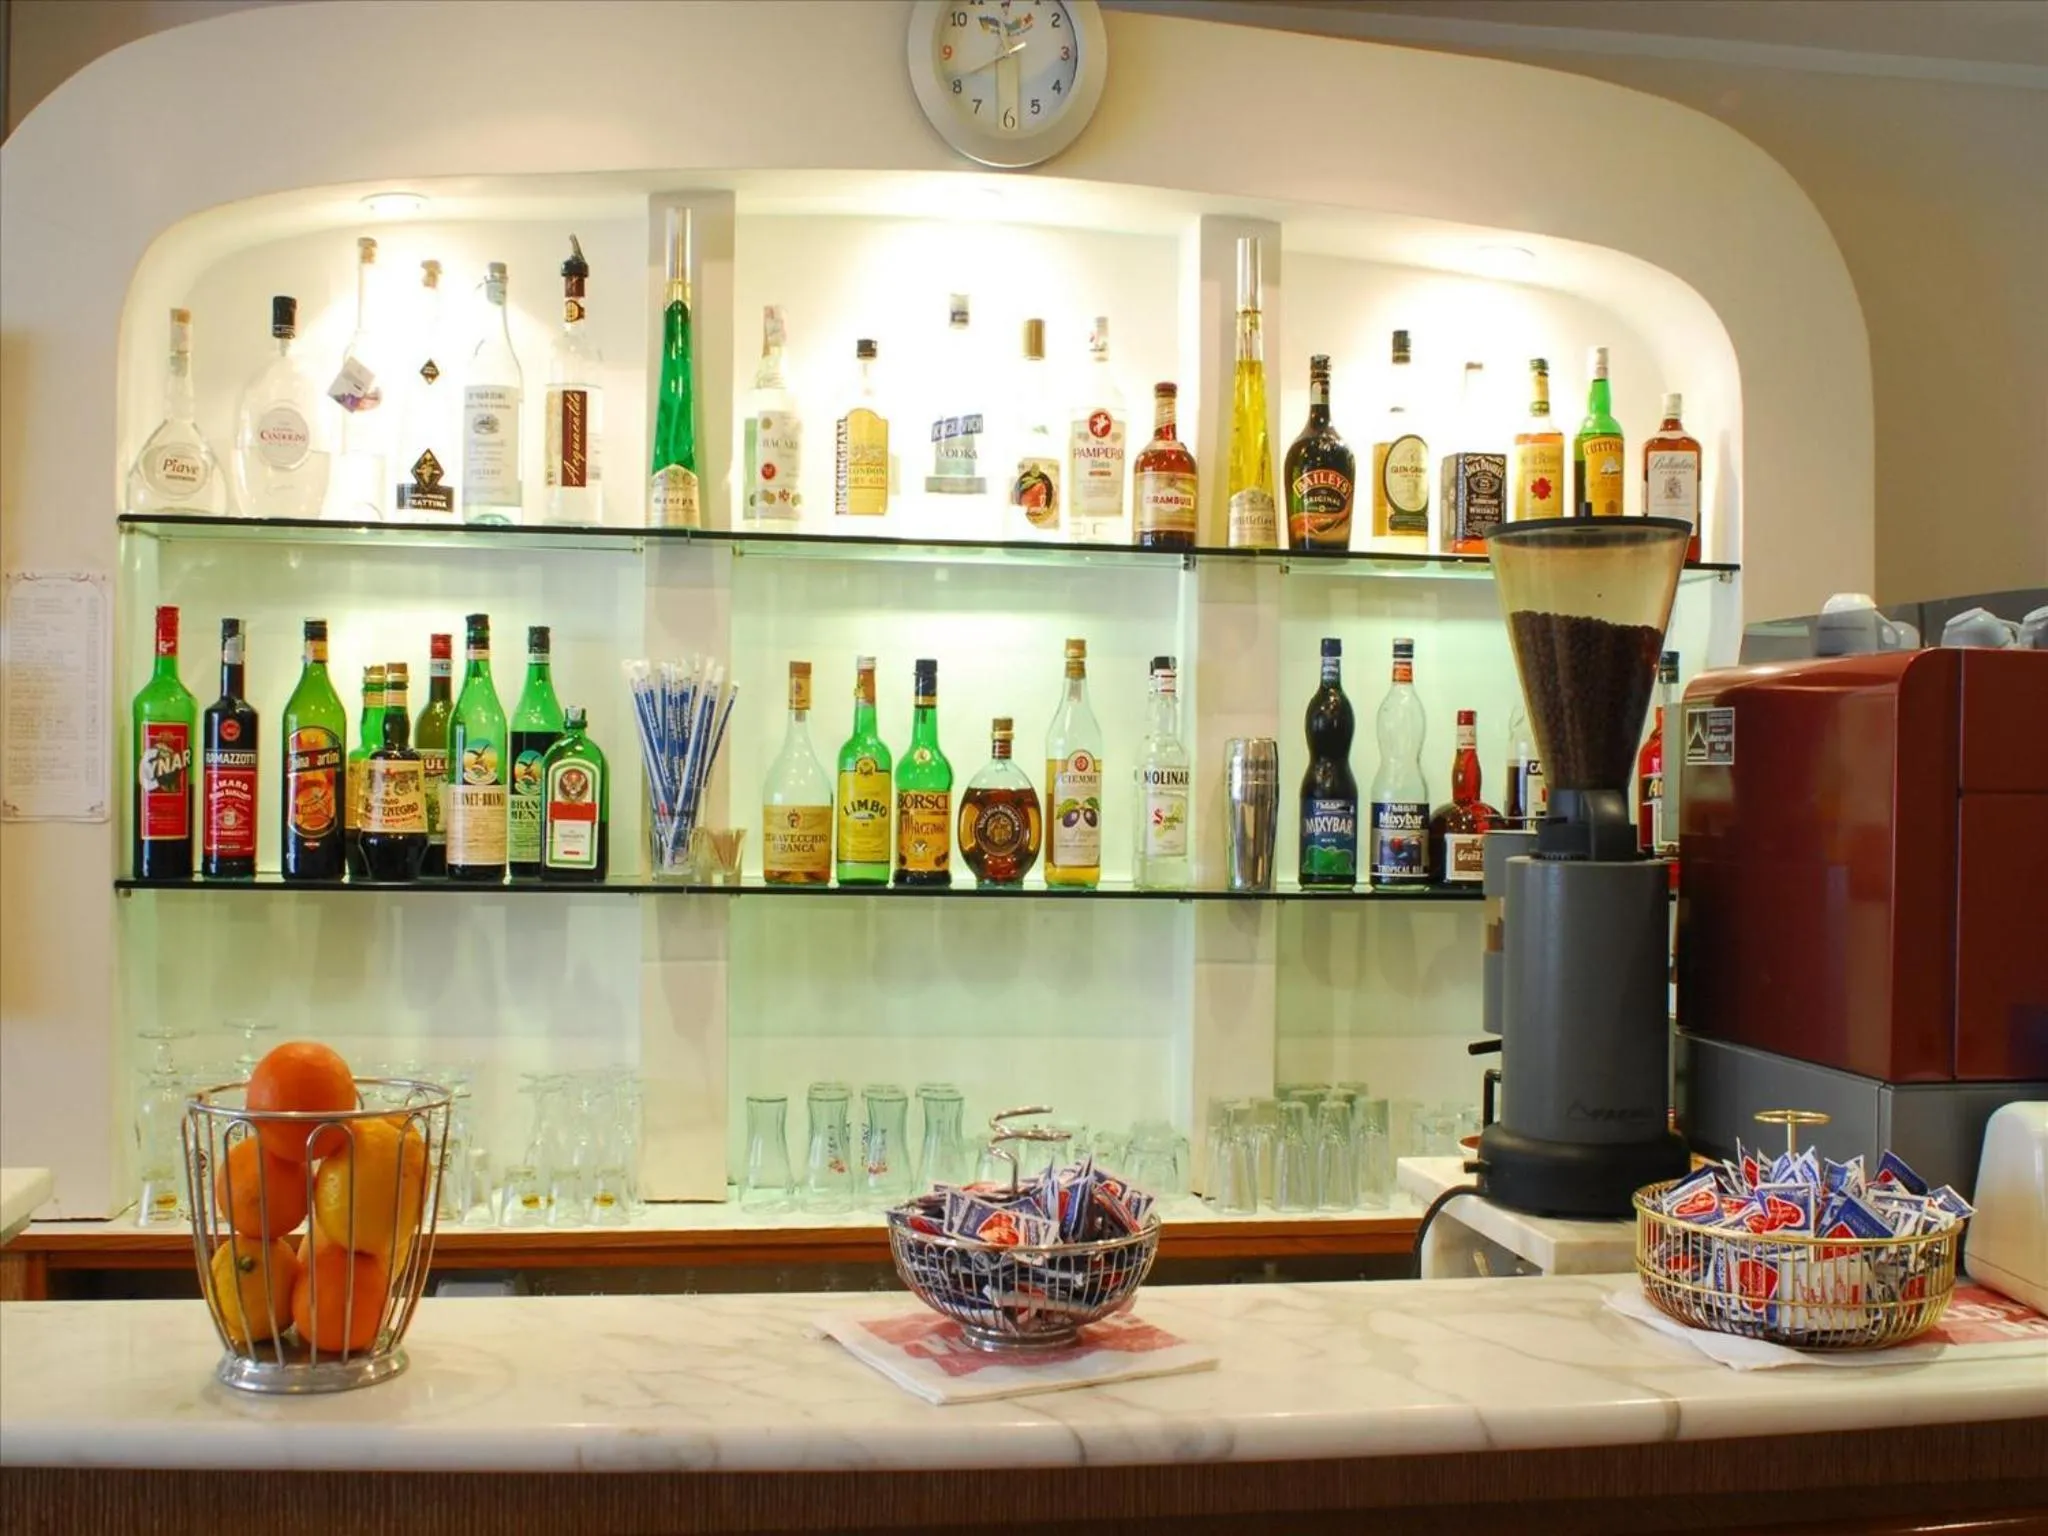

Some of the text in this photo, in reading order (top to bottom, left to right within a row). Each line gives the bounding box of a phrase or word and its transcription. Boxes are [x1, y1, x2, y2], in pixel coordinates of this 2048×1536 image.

[951, 12, 967, 27] 10
[1051, 13, 1061, 28] 2
[942, 45, 952, 60] 9
[1060, 46, 1070, 61] 3
[952, 79, 962, 94] 8
[1052, 79, 1062, 95] 4
[972, 99, 982, 114] 7
[1030, 99, 1041, 115] 5
[1003, 107, 1015, 129] 6
[1296, 471, 1350, 495] BAILEYS
[844, 799, 888, 817] LIMBO
[897, 793, 949, 809] BORSCI
[1379, 811, 1424, 828] Mixybar
